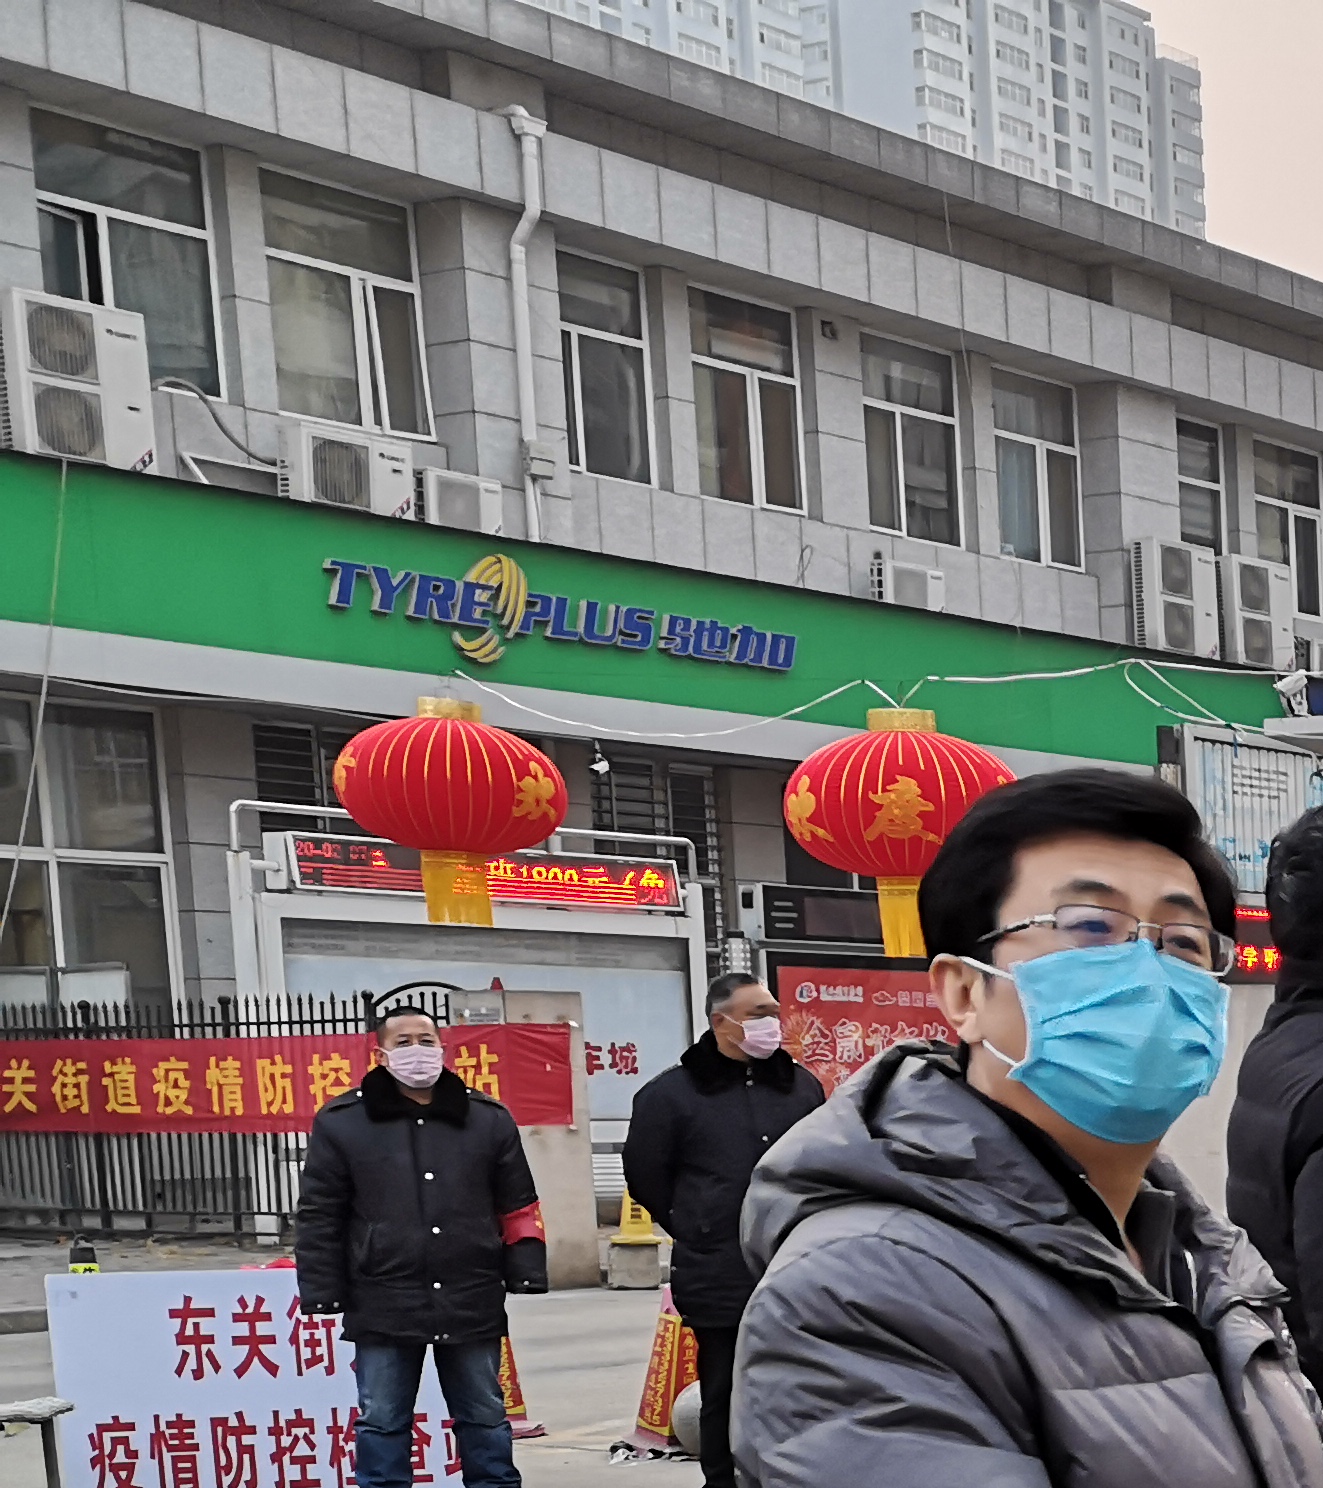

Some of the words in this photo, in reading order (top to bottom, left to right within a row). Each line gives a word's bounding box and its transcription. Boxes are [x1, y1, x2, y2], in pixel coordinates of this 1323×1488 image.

[324, 558, 497, 628] TYRE
[519, 592, 655, 650] PLUS
[658, 613, 797, 671] 驰加
[0, 1043, 501, 1116] 关街道疫情防控站
[168, 1294, 358, 1381] 东关街
